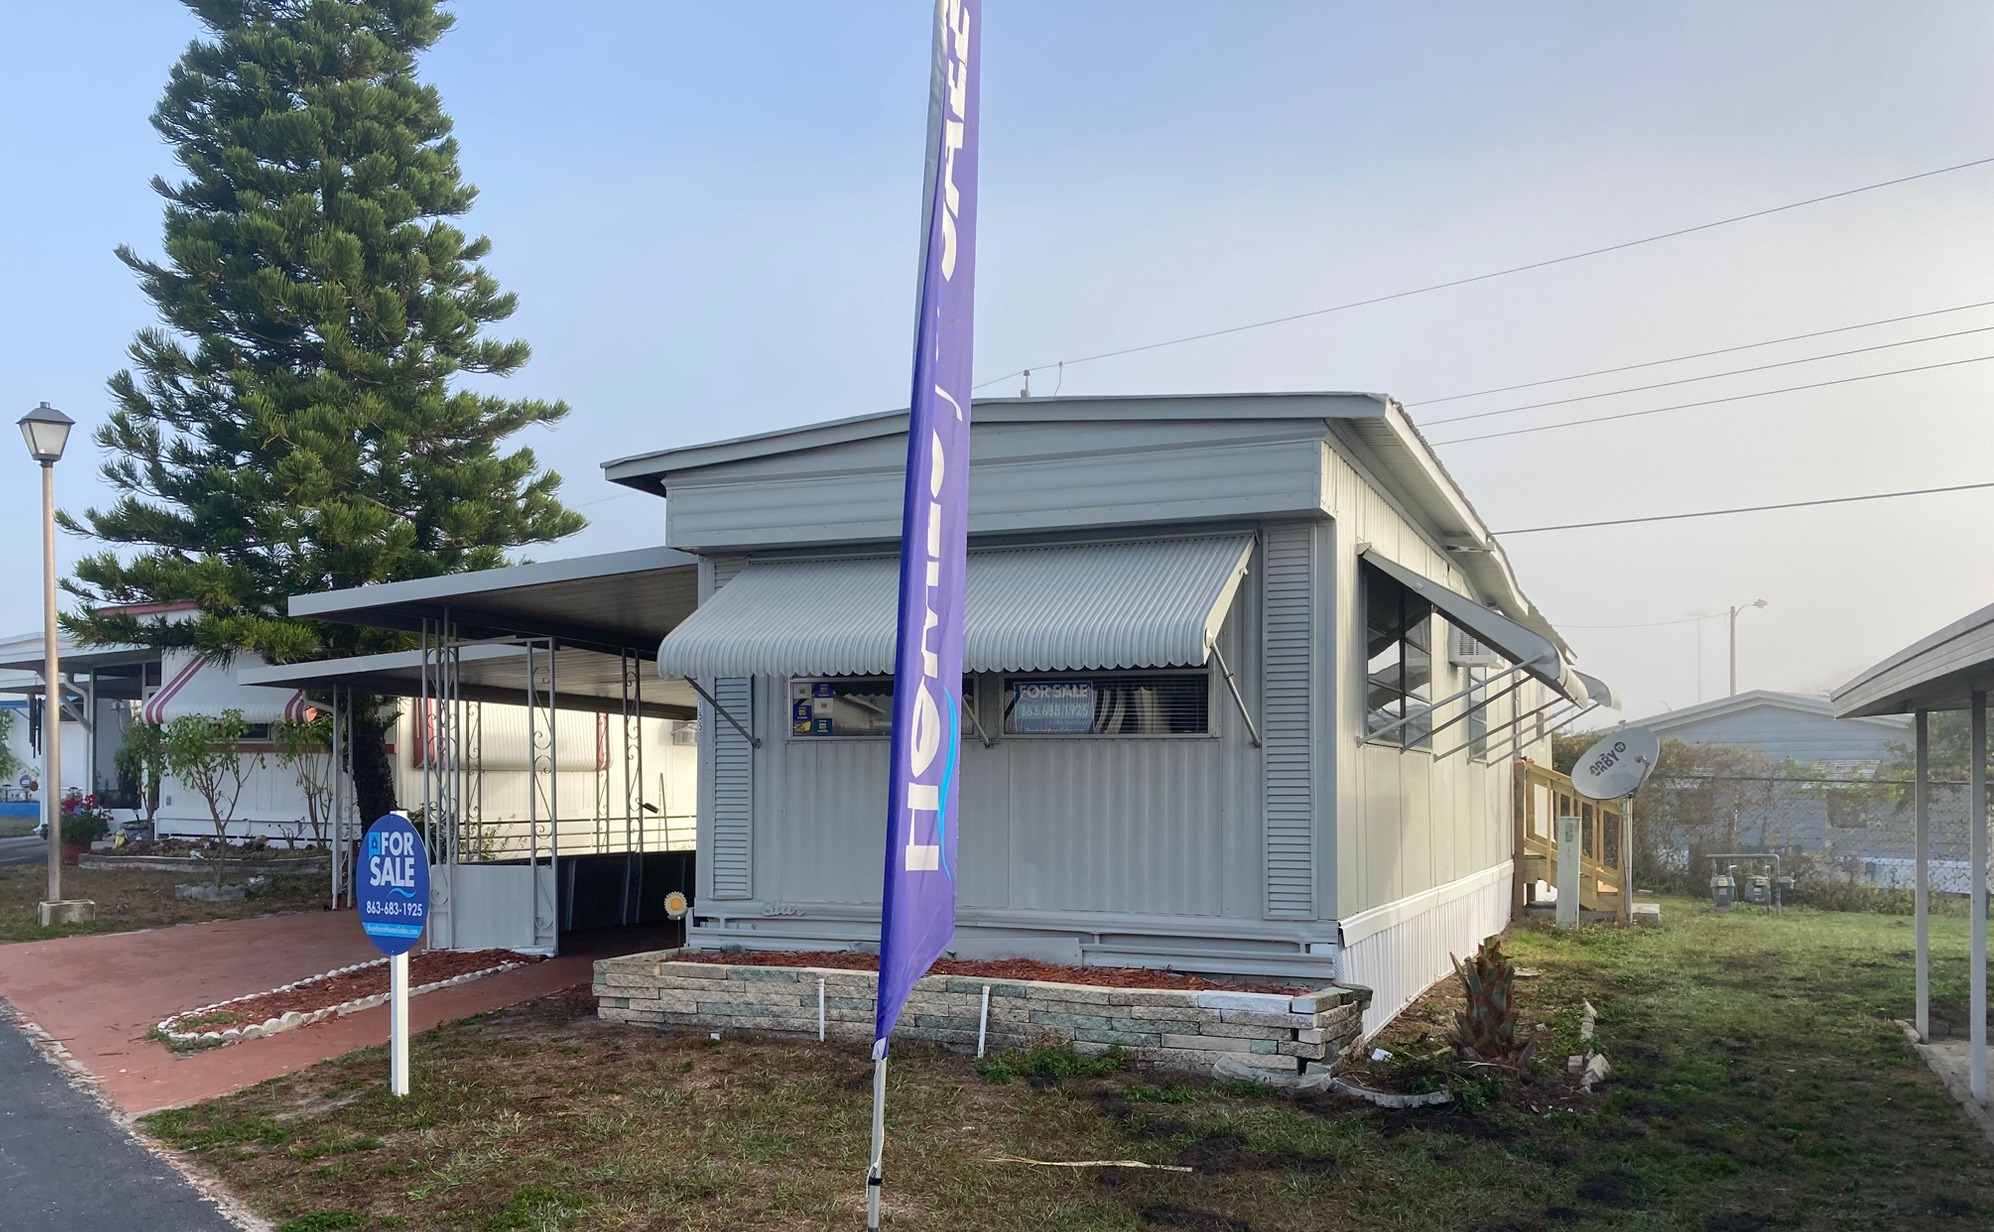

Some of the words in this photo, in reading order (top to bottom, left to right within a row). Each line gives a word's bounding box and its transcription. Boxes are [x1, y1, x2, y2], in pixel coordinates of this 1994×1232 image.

[1020, 684, 1051, 699] FOR
[1052, 684, 1088, 698] SALE
[381, 831, 414, 856] FOR
[370, 857, 415, 887] SALE
[366, 900, 423, 917] 863-683-1925
